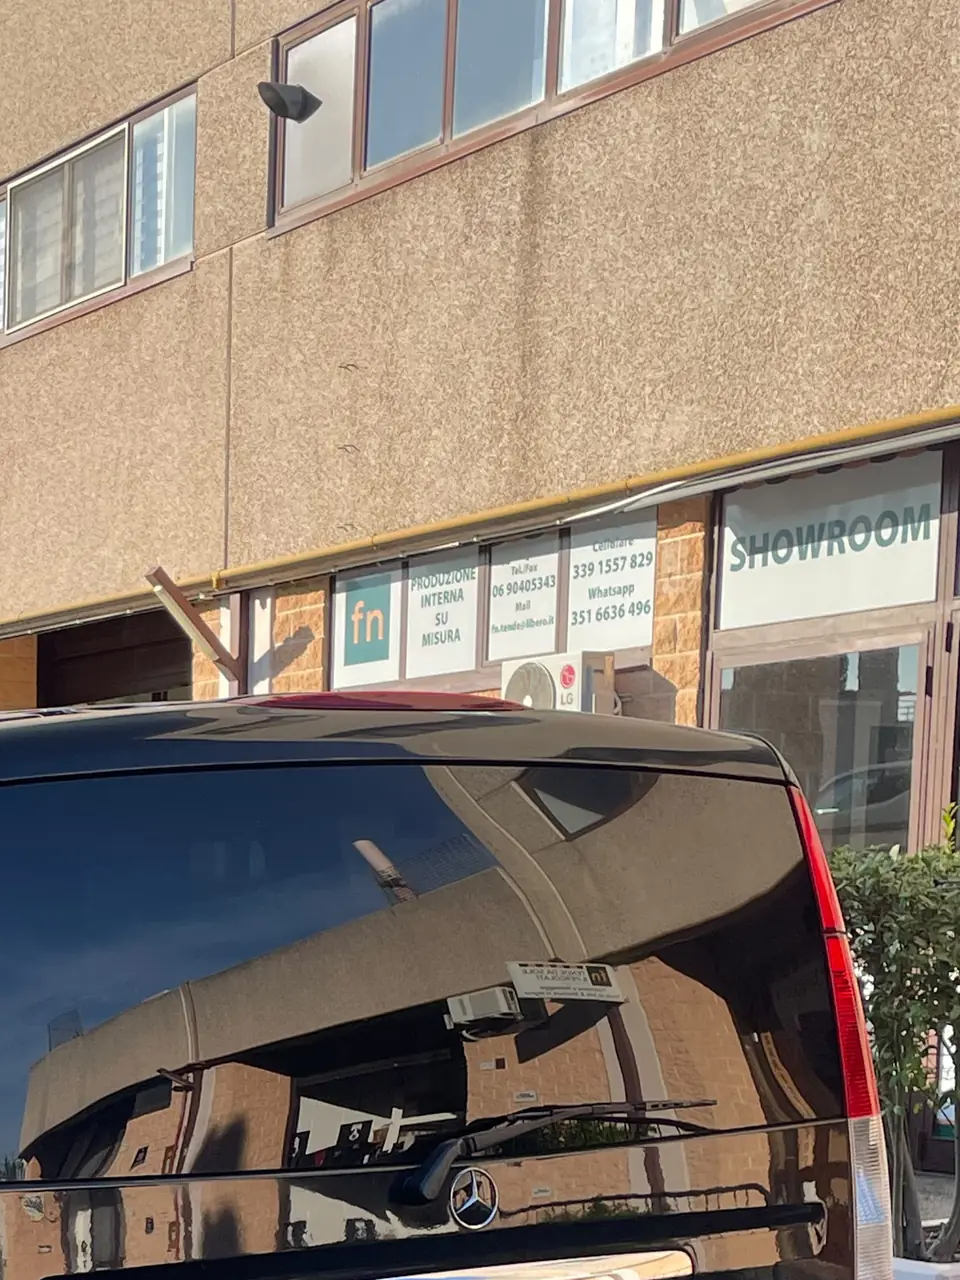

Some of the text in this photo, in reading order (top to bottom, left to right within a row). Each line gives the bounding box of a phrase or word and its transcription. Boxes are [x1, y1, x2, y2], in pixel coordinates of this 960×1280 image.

[730, 503, 931, 572] SHOWROOM
[573, 551, 653, 579] 339 1557 829
[410, 567, 476, 592] PRODUZIONE
[492, 574, 556, 598] 06 90405343
[588, 583, 635, 600] Whatsapp
[421, 587, 464, 609] INTERNA
[351, 600, 384, 645] fn
[435, 611, 449, 627] SU
[571, 599, 651, 626] 351 6636 496
[421, 628, 461, 647] MISURA
[560, 692, 574, 706] LG
